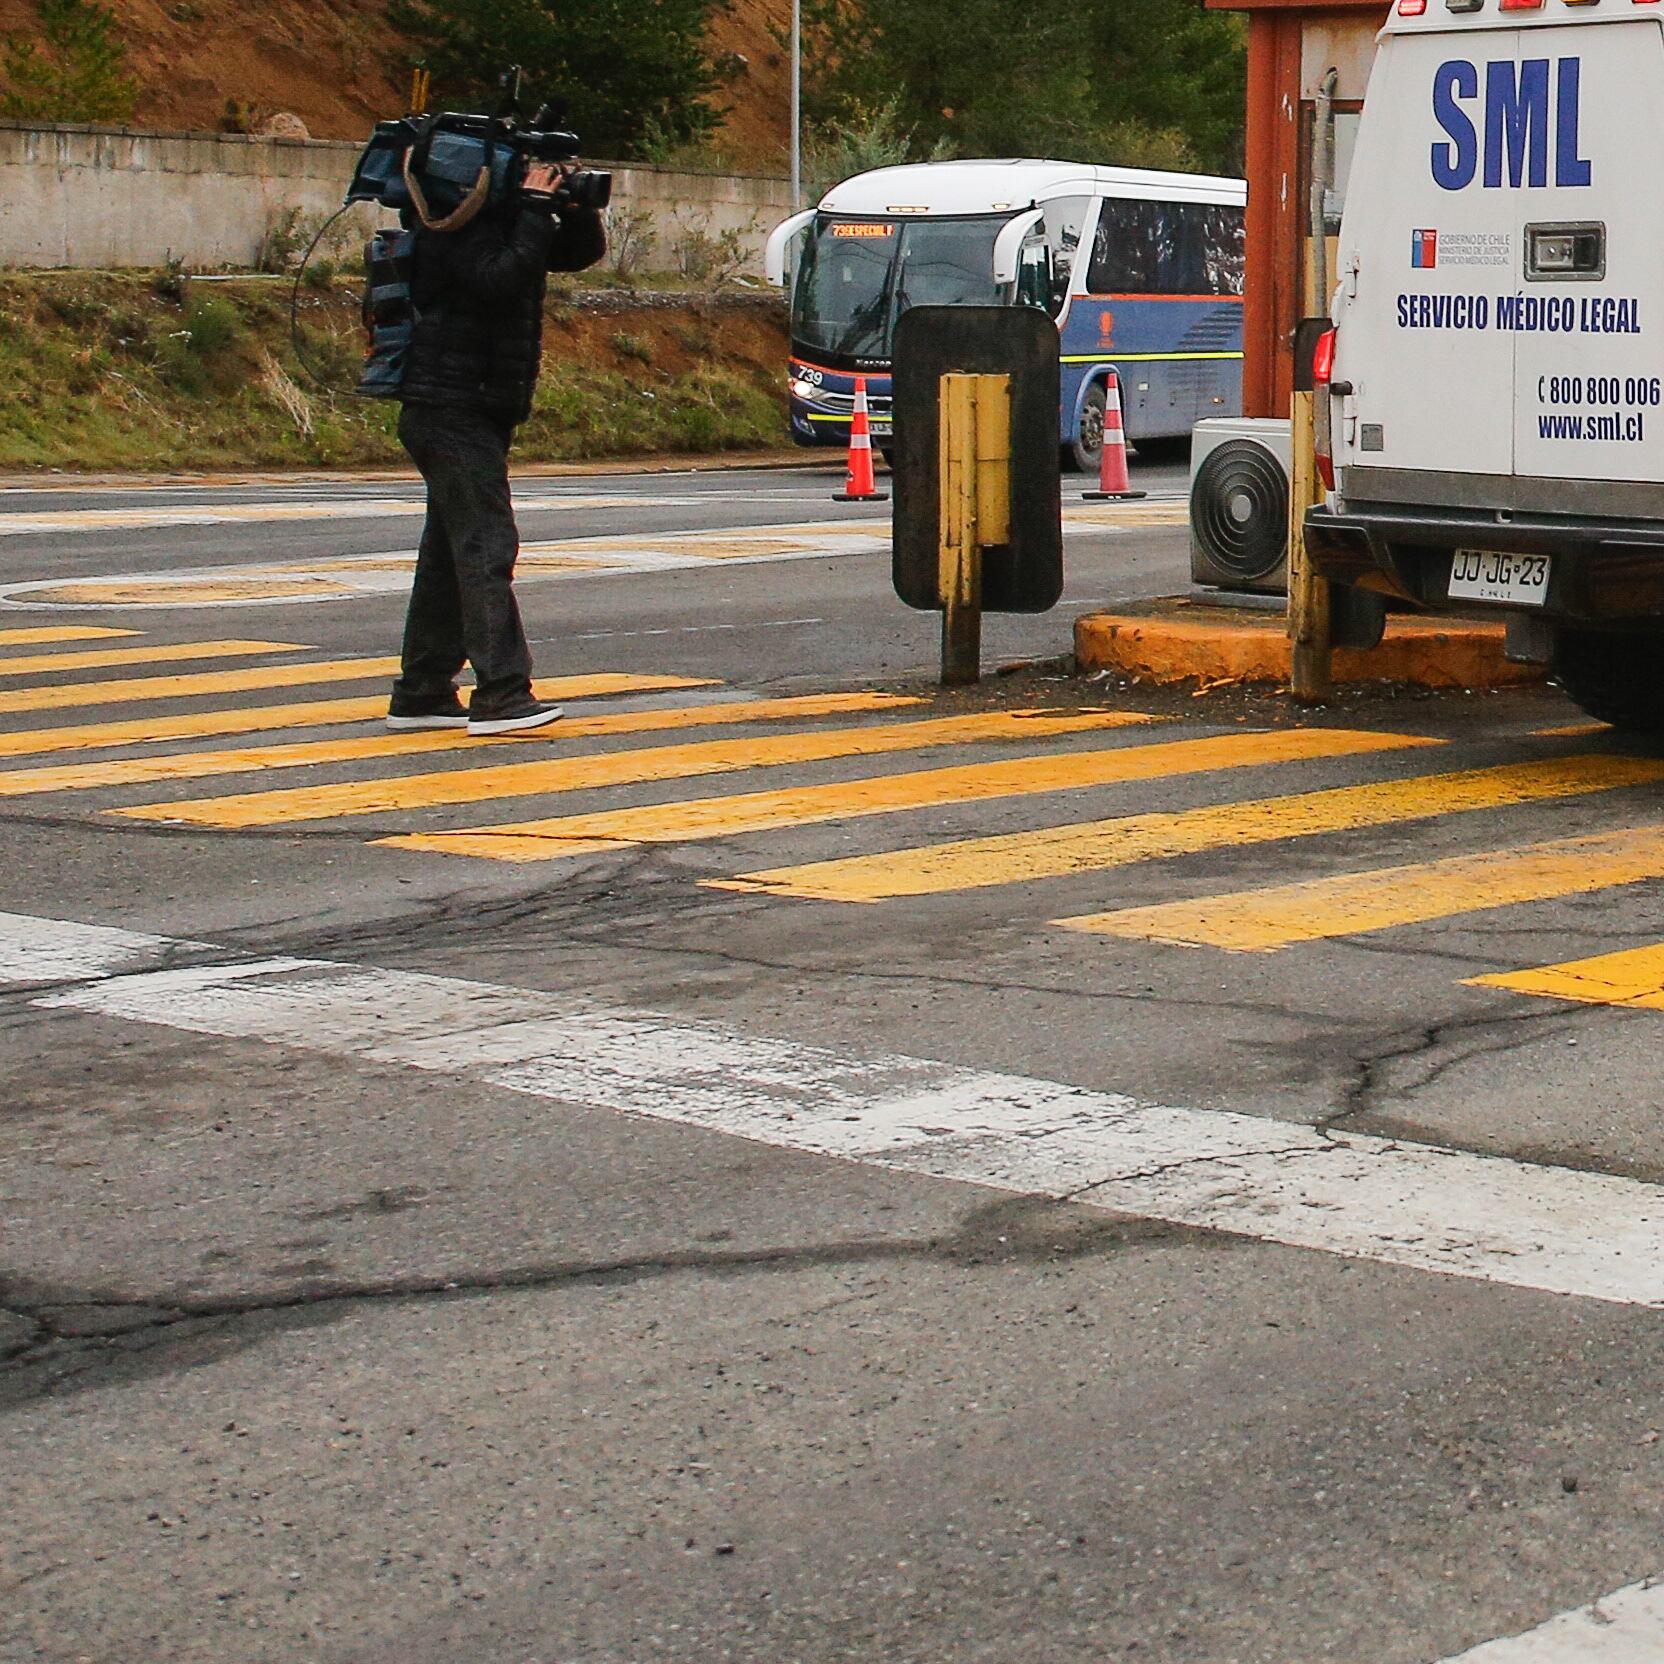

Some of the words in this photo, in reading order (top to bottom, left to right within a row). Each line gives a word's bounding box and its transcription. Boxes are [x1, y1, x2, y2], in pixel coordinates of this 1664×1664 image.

[1430, 55, 1592, 192] SML
[1488, 234, 1511, 246] CHILE
[1397, 293, 1489, 330] SERVICIO
[1496, 291, 1575, 333] MÉDICO
[1580, 297, 1641, 334] LEGAL
[797, 364, 824, 386] 739
[1550, 376, 1582, 404] 800
[1586, 377, 1620, 405] 800
[1625, 377, 1661, 406] 006
[1538, 412, 1644, 441] www.sml.cl
